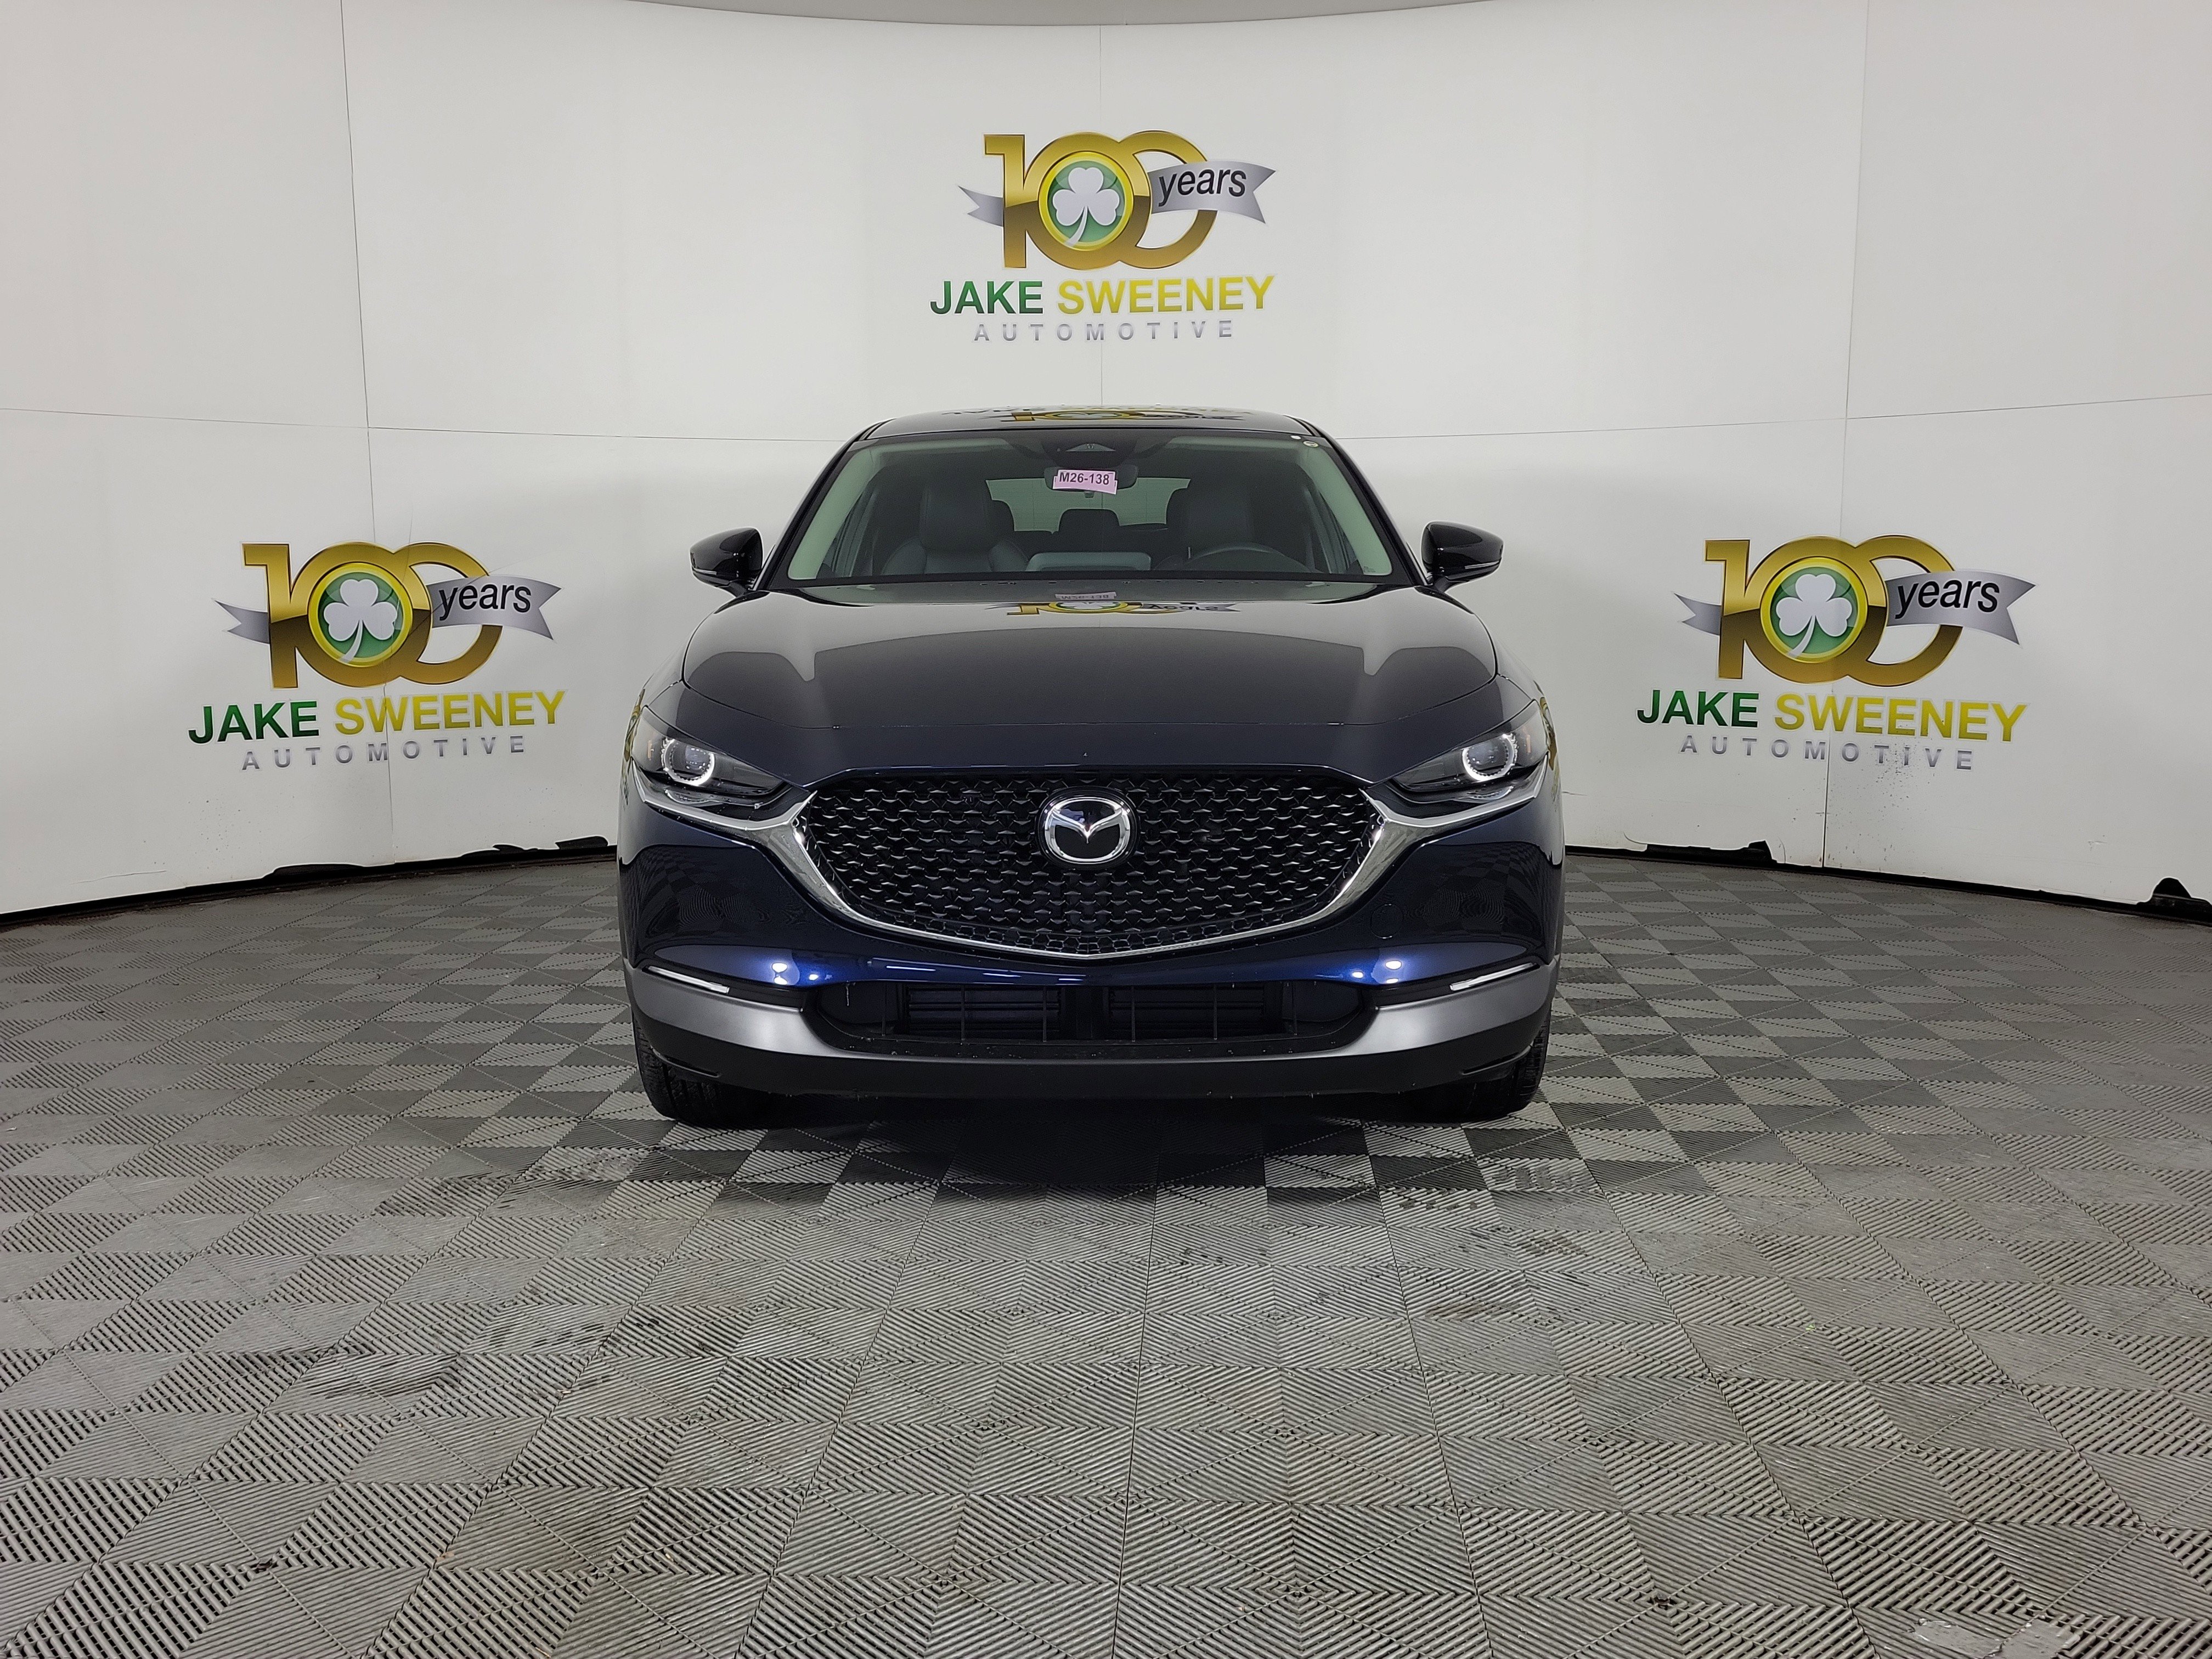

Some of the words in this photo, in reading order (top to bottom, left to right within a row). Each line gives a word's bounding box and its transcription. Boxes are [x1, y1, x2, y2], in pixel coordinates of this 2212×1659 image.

[983, 130, 1217, 270] 100
[1158, 168, 1247, 207] years
[930, 280, 1043, 315] JAKE
[1058, 275, 1276, 315] SWEENEY
[973, 320, 1232, 341] AUTOMOTIVE
[1059, 471, 1110, 486] M26-138
[241, 541, 503, 689] 100
[439, 583, 532, 621] years
[1705, 534, 1963, 687] 100
[1894, 579, 2000, 619] years
[188, 700, 319, 744] JAKE
[334, 690, 566, 736] SWEENEY
[1637, 690, 1759, 728] JAKE
[1774, 693, 2027, 742] SWEENEY
[241, 735, 524, 771] AUTOMOTIVE
[1680, 735, 1973, 771] AUTOMOTIVE
